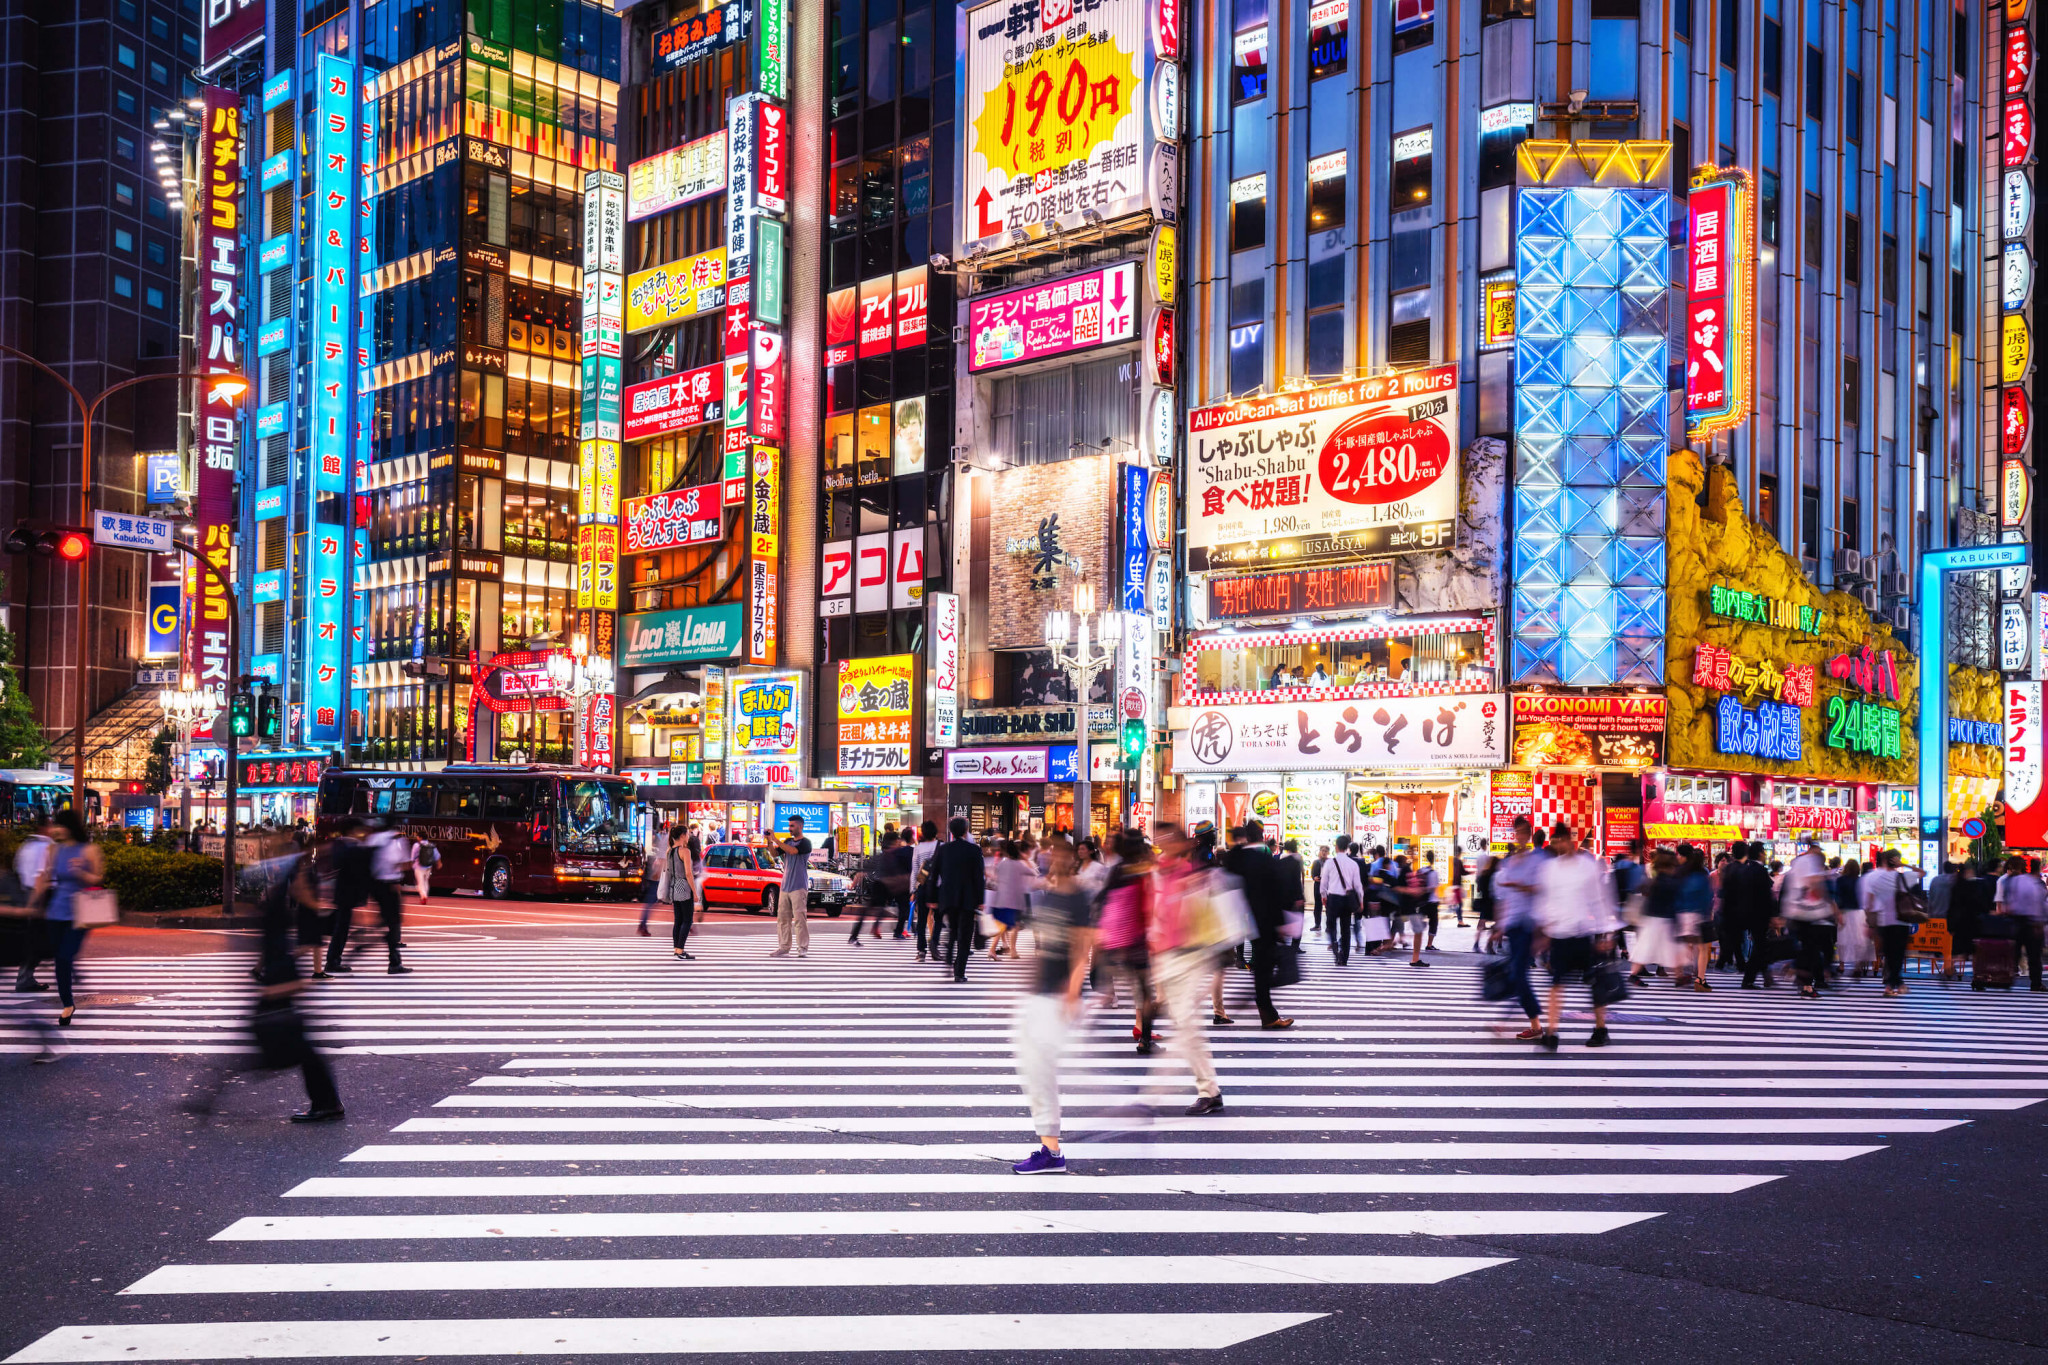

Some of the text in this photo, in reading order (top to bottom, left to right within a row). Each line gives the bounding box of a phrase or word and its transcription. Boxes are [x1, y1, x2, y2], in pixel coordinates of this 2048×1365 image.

[659, 10, 721, 56] お好み焼
[2008, 41, 2029, 79] つぼ八
[760, 70, 768, 91] 6F
[2008, 84, 2022, 94] 8F
[1000, 58, 1121, 147] 190円
[2006, 113, 2028, 151] つぼ八
[212, 106, 238, 229] パチンコ
[765, 125, 780, 194] アイフル
[2006, 156, 2022, 165] 7F
[677, 178, 716, 197] マンボー
[732, 116, 748, 254] お好み焼き本陣
[765, 197, 778, 208] 5F
[1006, 179, 1127, 230] 左の路地を右へ
[2005, 225, 2023, 237] 6F
[1694, 210, 1719, 293] 居酒屋
[691, 258, 722, 288] 焼き
[1159, 247, 1173, 286] 虎の子
[631, 270, 667, 308] お好み
[642, 274, 687, 317] もんじゃ
[715, 289, 726, 306] 7F
[861, 284, 927, 324] アイフル
[976, 278, 1100, 326] ブランド高価買取
[2008, 301, 2019, 309] 5F
[902, 316, 926, 333] 募集中
[1030, 312, 1066, 330] ロコシーラ
[1074, 306, 1098, 325] TAX
[1107, 315, 1130, 336] 1F
[1496, 300, 1512, 329] 虎の子
[1026, 330, 1047, 347] Roko
[1048, 324, 1071, 342] Shira
[1074, 323, 1099, 342] FREE
[1688, 308, 1724, 378] つぼ八
[834, 350, 847, 362] 5F
[2007, 333, 2026, 366] 虎の子
[2005, 372, 2018, 380] 4F
[760, 372, 775, 421] アコム
[1194, 373, 1453, 429] All-you-can-eat buffet for 2 hours
[705, 402, 720, 420] 4F
[1410, 400, 1445, 422] 120分
[760, 423, 774, 434] 3F
[1199, 419, 1317, 463] しゃぶしゃぶ
[464, 454, 500, 471] DOUTOR
[1159, 455, 1168, 465] 1F
[825, 475, 853, 489] Neolive
[628, 489, 700, 524] しゃぶしゃぶ
[753, 477, 772, 536] 金の蔵
[102, 516, 167, 537] 歌舞伎町
[628, 519, 690, 549] うどんすき
[704, 519, 719, 536] 4F
[1390, 522, 1452, 547] 当ビル 5F
[113, 532, 155, 545] Kabukicho
[756, 537, 773, 553] 2F
[1306, 537, 1363, 554] USAGIYA
[461, 559, 499, 574] DOUTOR
[824, 542, 923, 594] アコム
[599, 595, 612, 606] 6F
[1156, 569, 1169, 611] かっぱ
[753, 563, 766, 656] 東京チカラめし
[829, 600, 845, 614] 3F
[316, 536, 339, 727] カラオケ館
[1157, 616, 1168, 625] B1
[2003, 615, 2021, 654] かっぱ
[839, 661, 850, 673] 2F
[2006, 657, 2020, 666] B1
[1696, 643, 1815, 708] 東京カラオケ本舗
[1828, 645, 1901, 701] つぼ八
[742, 688, 791, 713] まんが
[858, 679, 910, 712] 金の蔵
[1516, 697, 1665, 714] OKONOMI YAKI
[2029, 683, 2040, 728] 大衆酒場
[938, 708, 954, 716] TAX
[938, 715, 954, 723] FREE
[1516, 714, 1664, 725] All-You-Can-Eat dinner with Free-Flowing
[752, 716, 780, 737] 喫茶
[840, 721, 911, 742] 元祖 焼き牛丼
[1240, 724, 1289, 738] 立ちそば
[1297, 701, 1467, 755] とらそば
[1573, 723, 1598, 731] Drinks
[1639, 724, 1664, 732] ¥2,700
[1716, 695, 1801, 761] 飲み放題
[1826, 696, 1901, 760] 24時間
[2009, 689, 2027, 763] トラノコ
[849, 745, 910, 770] チカラめし
[982, 755, 1008, 776] Roko
[1010, 754, 1038, 775] Shira
[780, 806, 823, 815] SUBNADE
[1785, 807, 1849, 830] カラオケBOX
